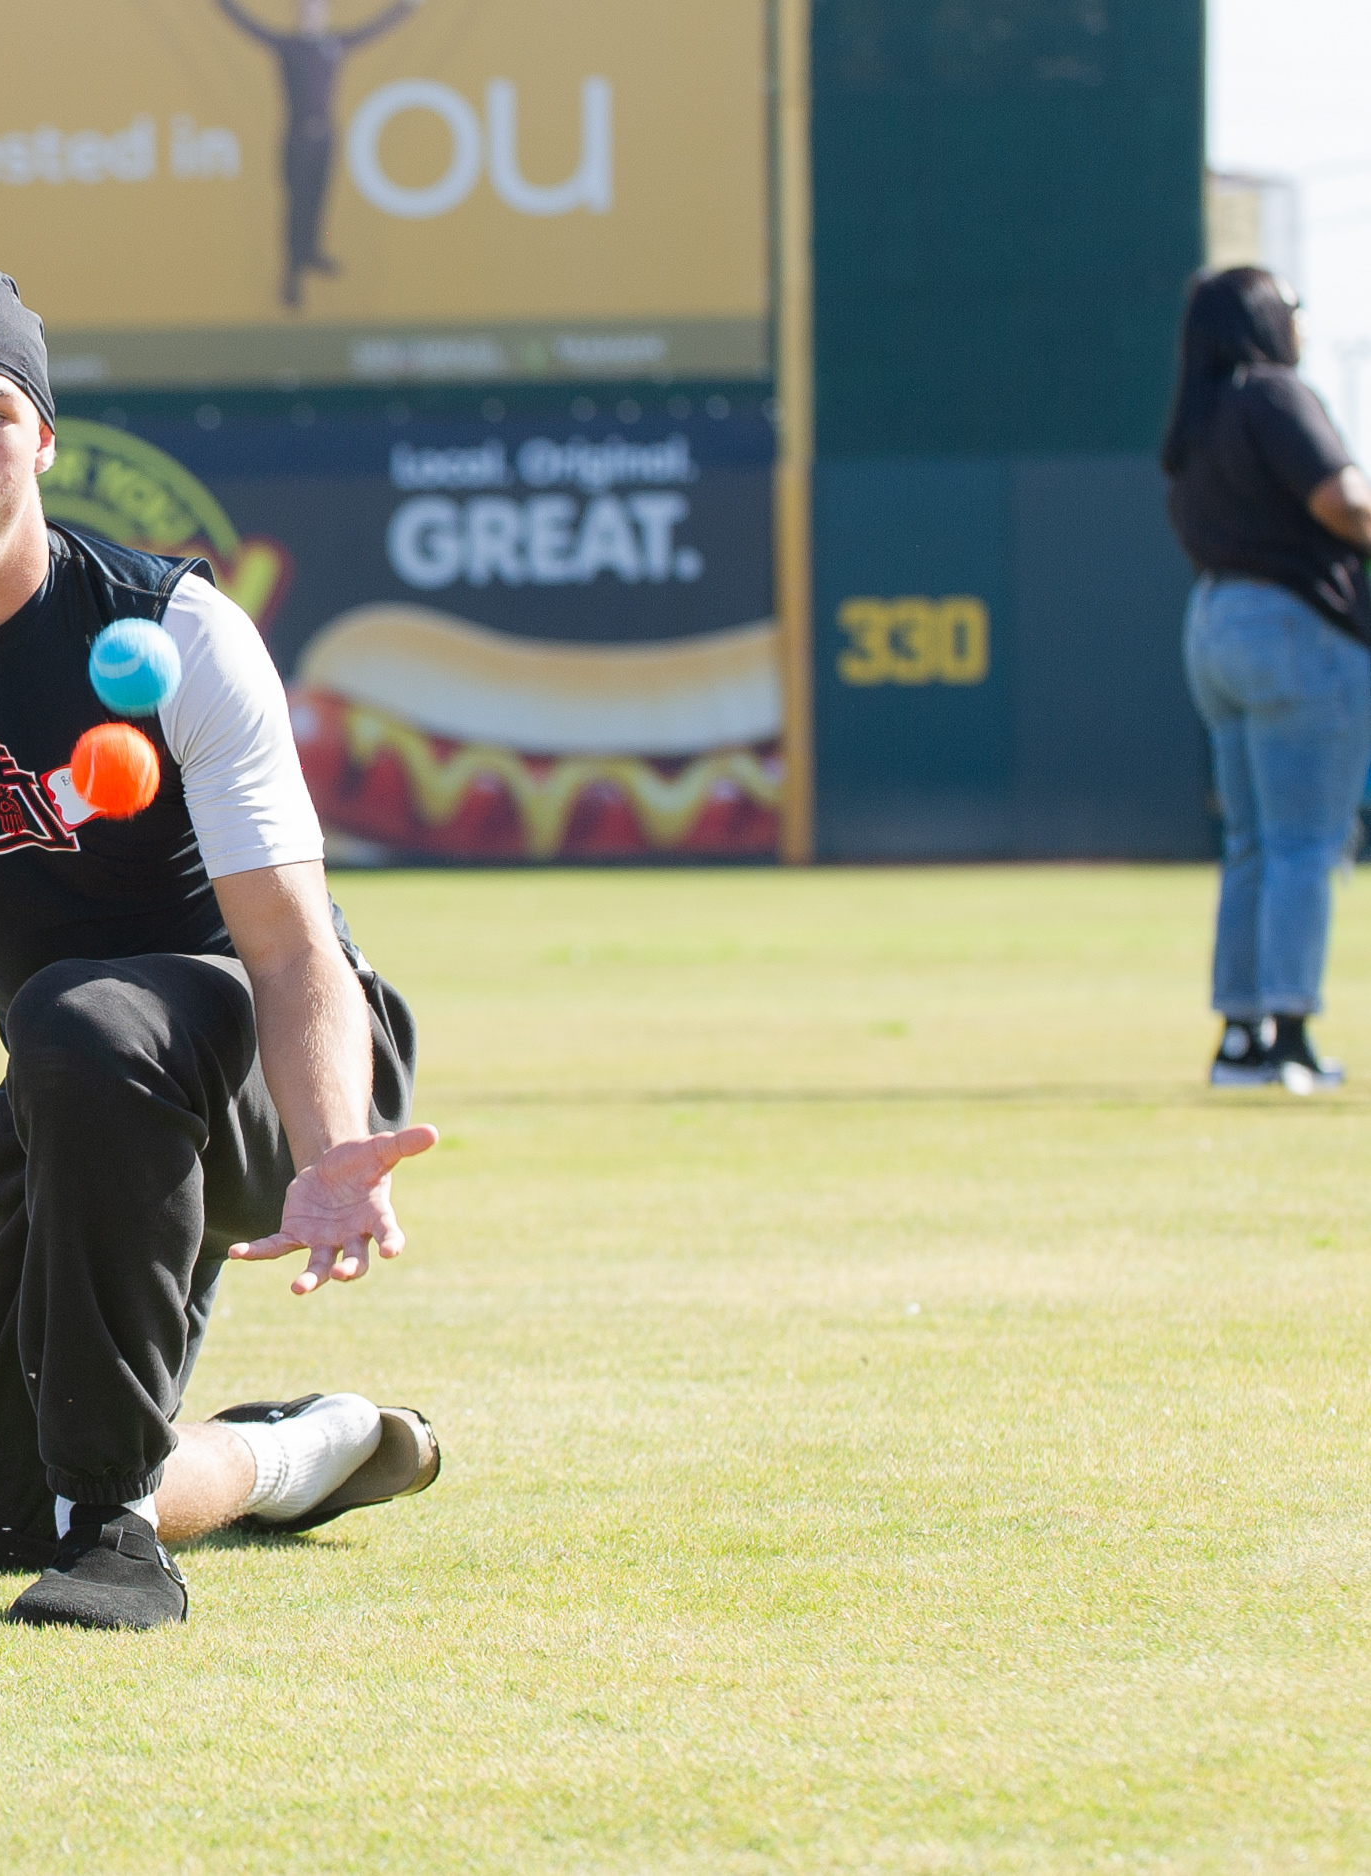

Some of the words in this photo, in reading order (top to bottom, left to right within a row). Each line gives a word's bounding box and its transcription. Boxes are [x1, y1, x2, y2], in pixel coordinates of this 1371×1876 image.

[169, 112, 241, 181] in
[386, 494, 705, 591] GREAT.
[836, 597, 990, 686] 330
